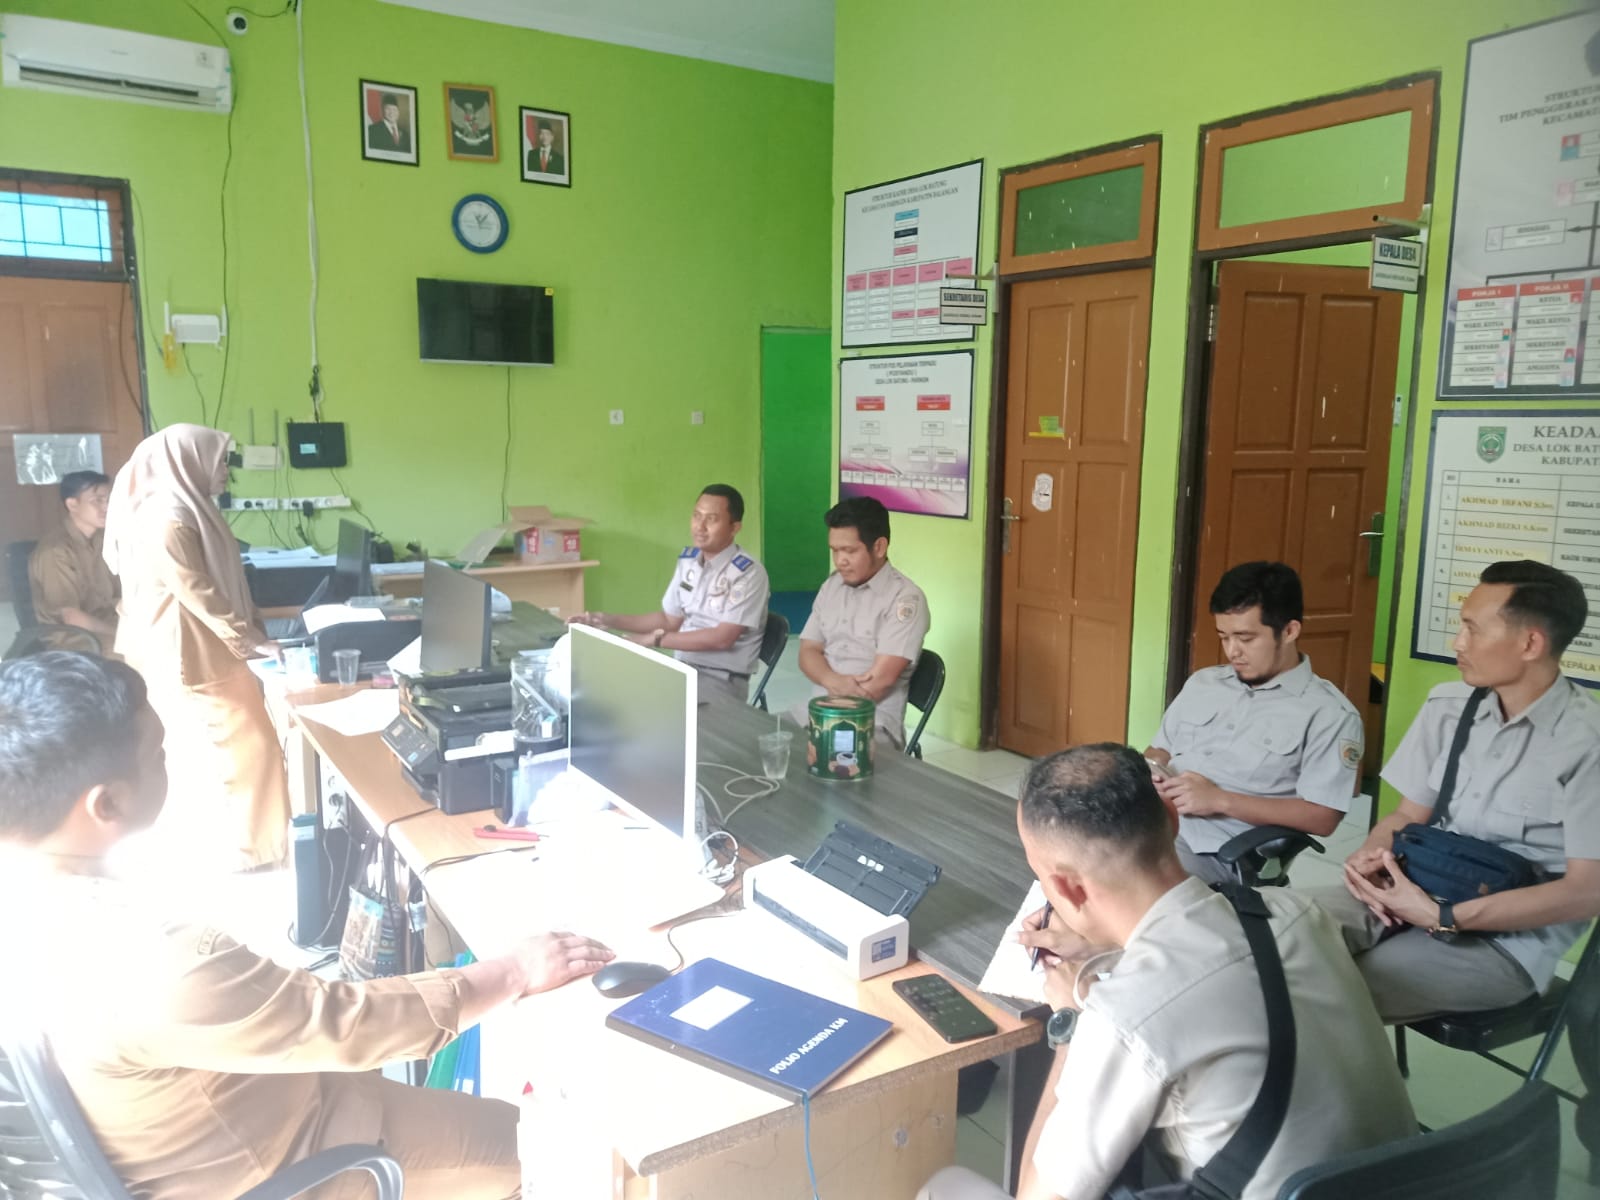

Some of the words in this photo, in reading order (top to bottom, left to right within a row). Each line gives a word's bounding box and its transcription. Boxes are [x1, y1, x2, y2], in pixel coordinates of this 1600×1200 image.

[1499, 112, 1518, 123] TIM
[1520, 98, 1588, 119] PENGGERAK
[1533, 425, 1600, 439] KEADA
[1513, 443, 1543, 452] DESA
[1547, 444, 1570, 453] LOK
[1575, 444, 1600, 453] BAT
[1541, 456, 1600, 466] KABUPAT
[769, 1052, 801, 1075] FOLIO
[797, 1028, 836, 1055] AGENDA
[829, 1017, 849, 1030] KM
